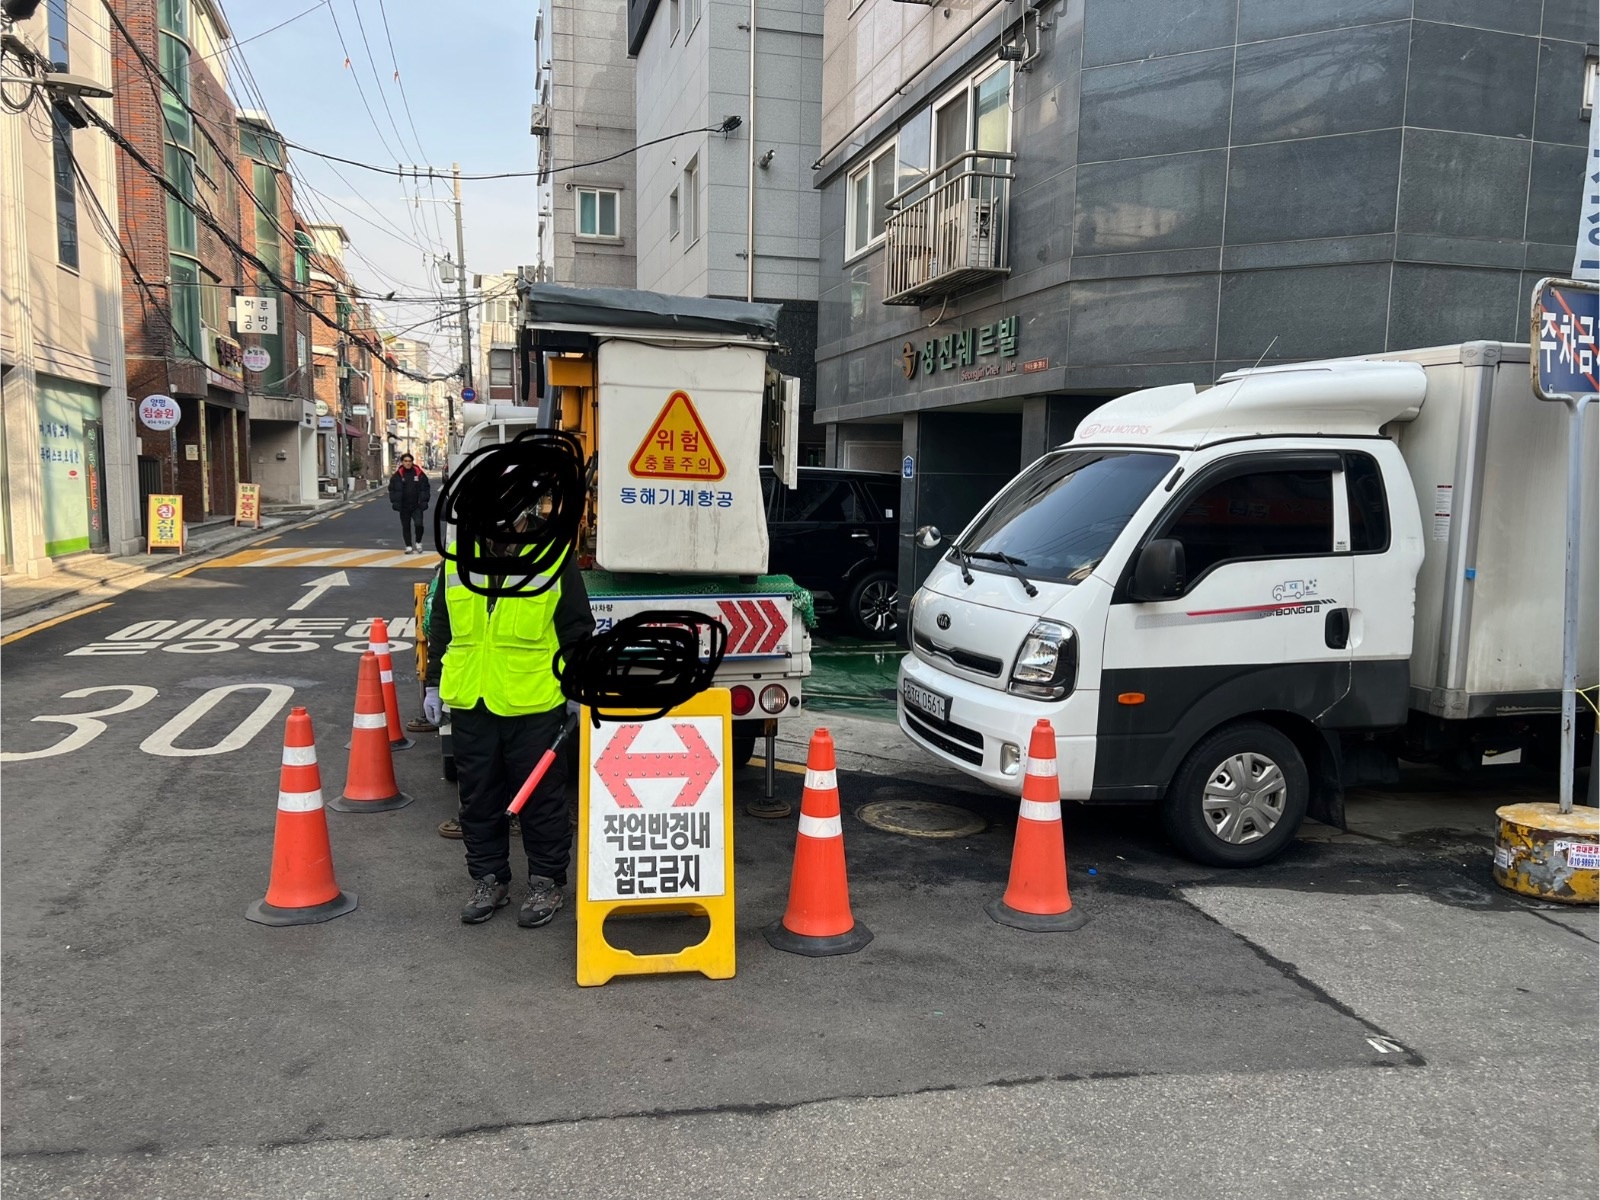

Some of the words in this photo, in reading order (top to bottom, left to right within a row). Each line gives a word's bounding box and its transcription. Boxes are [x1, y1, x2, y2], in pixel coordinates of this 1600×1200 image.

[244, 300, 268, 311] 하루
[244, 315, 268, 331] 공방
[921, 315, 1020, 375] 성진쉐르빌
[1540, 312, 1599, 374] 주차금
[142, 407, 174, 419] 침술원
[150, 398, 166, 407] 양평
[656, 429, 699, 452] 위험
[644, 454, 712, 473] 충돌주의
[240, 494, 255, 519] 부동산
[619, 487, 734, 509] 동해기계항공
[158, 505, 173, 518] 침
[590, 603, 613, 612] 사차량
[1275, 605, 1313, 616] BONGO
[64, 617, 415, 656] 일방통행
[922, 692, 941, 716] 0561
[1, 683, 295, 762] 30
[603, 811, 711, 852] 작업반경내
[614, 854, 701, 895] 접근금지
